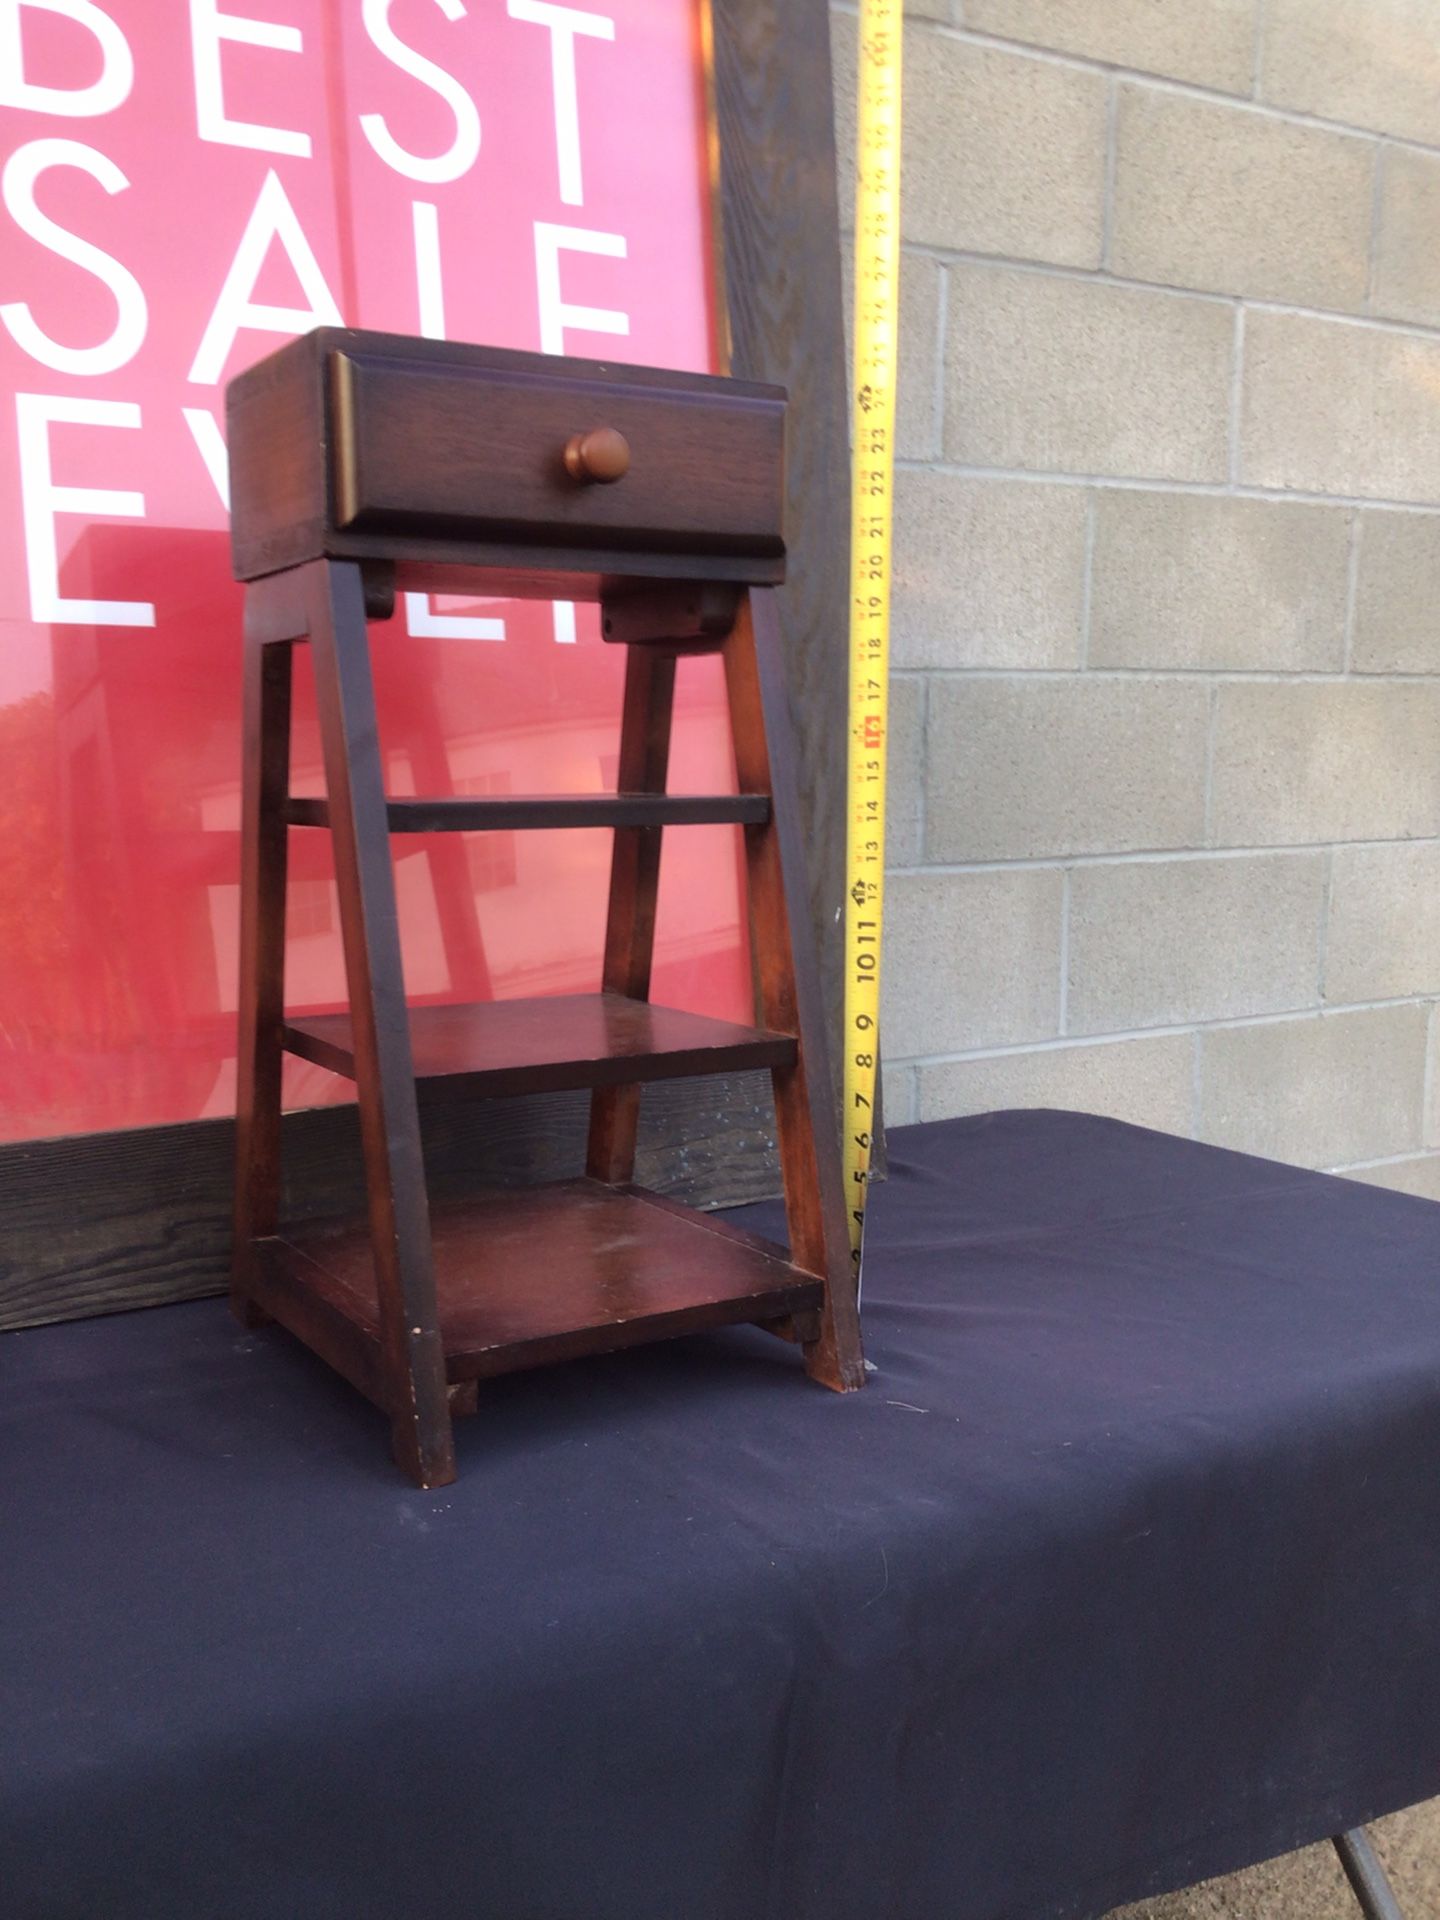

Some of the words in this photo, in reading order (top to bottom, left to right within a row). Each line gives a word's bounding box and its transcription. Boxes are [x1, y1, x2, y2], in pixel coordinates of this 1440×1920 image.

[0, 0, 614, 207] BEST
[871, 429, 885, 454] 23
[870, 471, 884, 496] 22
[870, 516, 884, 538] 21
[869, 555, 883, 580] 20
[869, 597, 882, 618] 19
[868, 638, 882, 659] 18
[867, 679, 880, 700] 17
[865, 717, 880, 745] 16
[866, 761, 879, 781] 15
[866, 801, 879, 821] 14
[865, 841, 879, 862] 13
[867, 883, 878, 899] 12
[857, 921, 877, 944] 11
[856, 953, 876, 983] 10
[855, 1014, 873, 1031] 9
[855, 1054, 873, 1069] 8
[855, 1092, 871, 1109] 7
[854, 1132, 869, 1149] 6
[853, 1170, 867, 1184] 5
